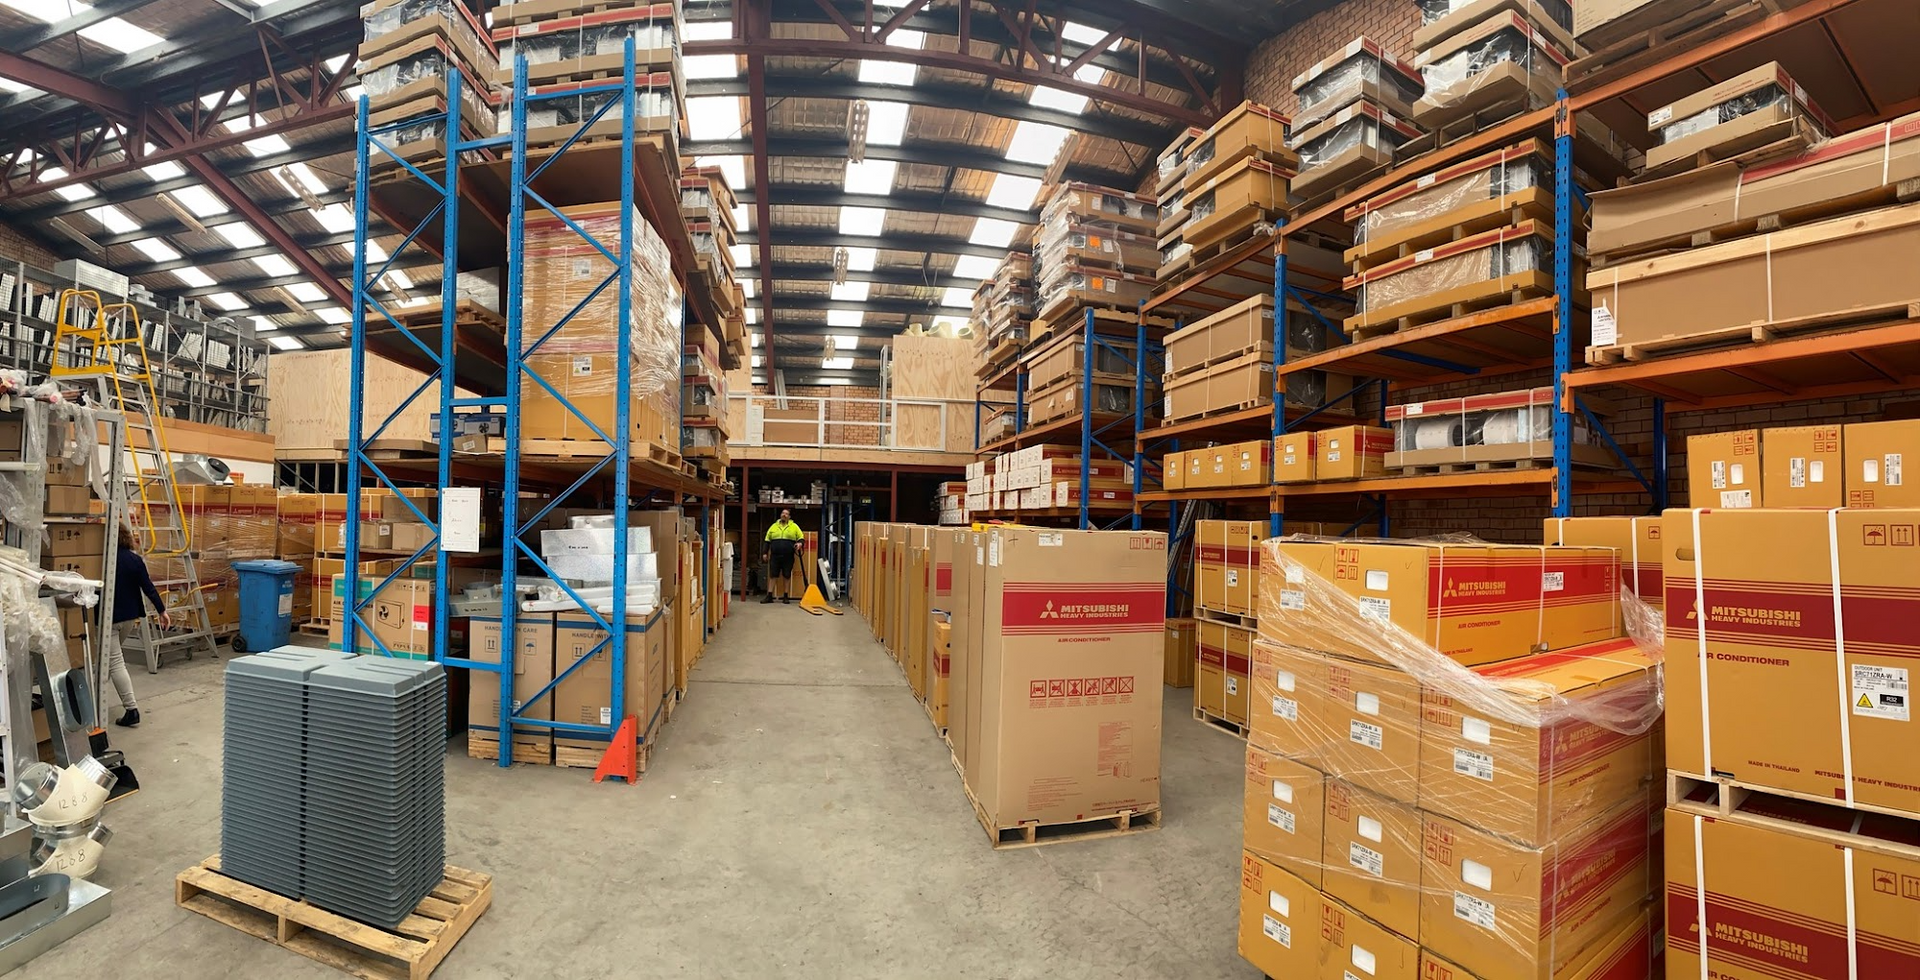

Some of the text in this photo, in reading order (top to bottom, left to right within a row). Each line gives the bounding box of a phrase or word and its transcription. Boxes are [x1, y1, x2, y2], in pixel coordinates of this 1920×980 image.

[1459, 581, 1506, 590] MITSUBISHI
[1061, 604, 1129, 613] MITSUBISHI
[1711, 606, 1801, 621] MITSUBISHI
[1467, 620, 1501, 628] CONDITIONER
[1711, 615, 1801, 628] HEAVY INDUSTRIES
[1716, 653, 1790, 667] CONDITIONER
[1771, 764, 1800, 773] THAILAND
[1857, 777, 1883, 786] HEAVY
[1715, 922, 1808, 956] MITSUBISHI
[1715, 932, 1808, 963] HEAVY INDUSTRIES
